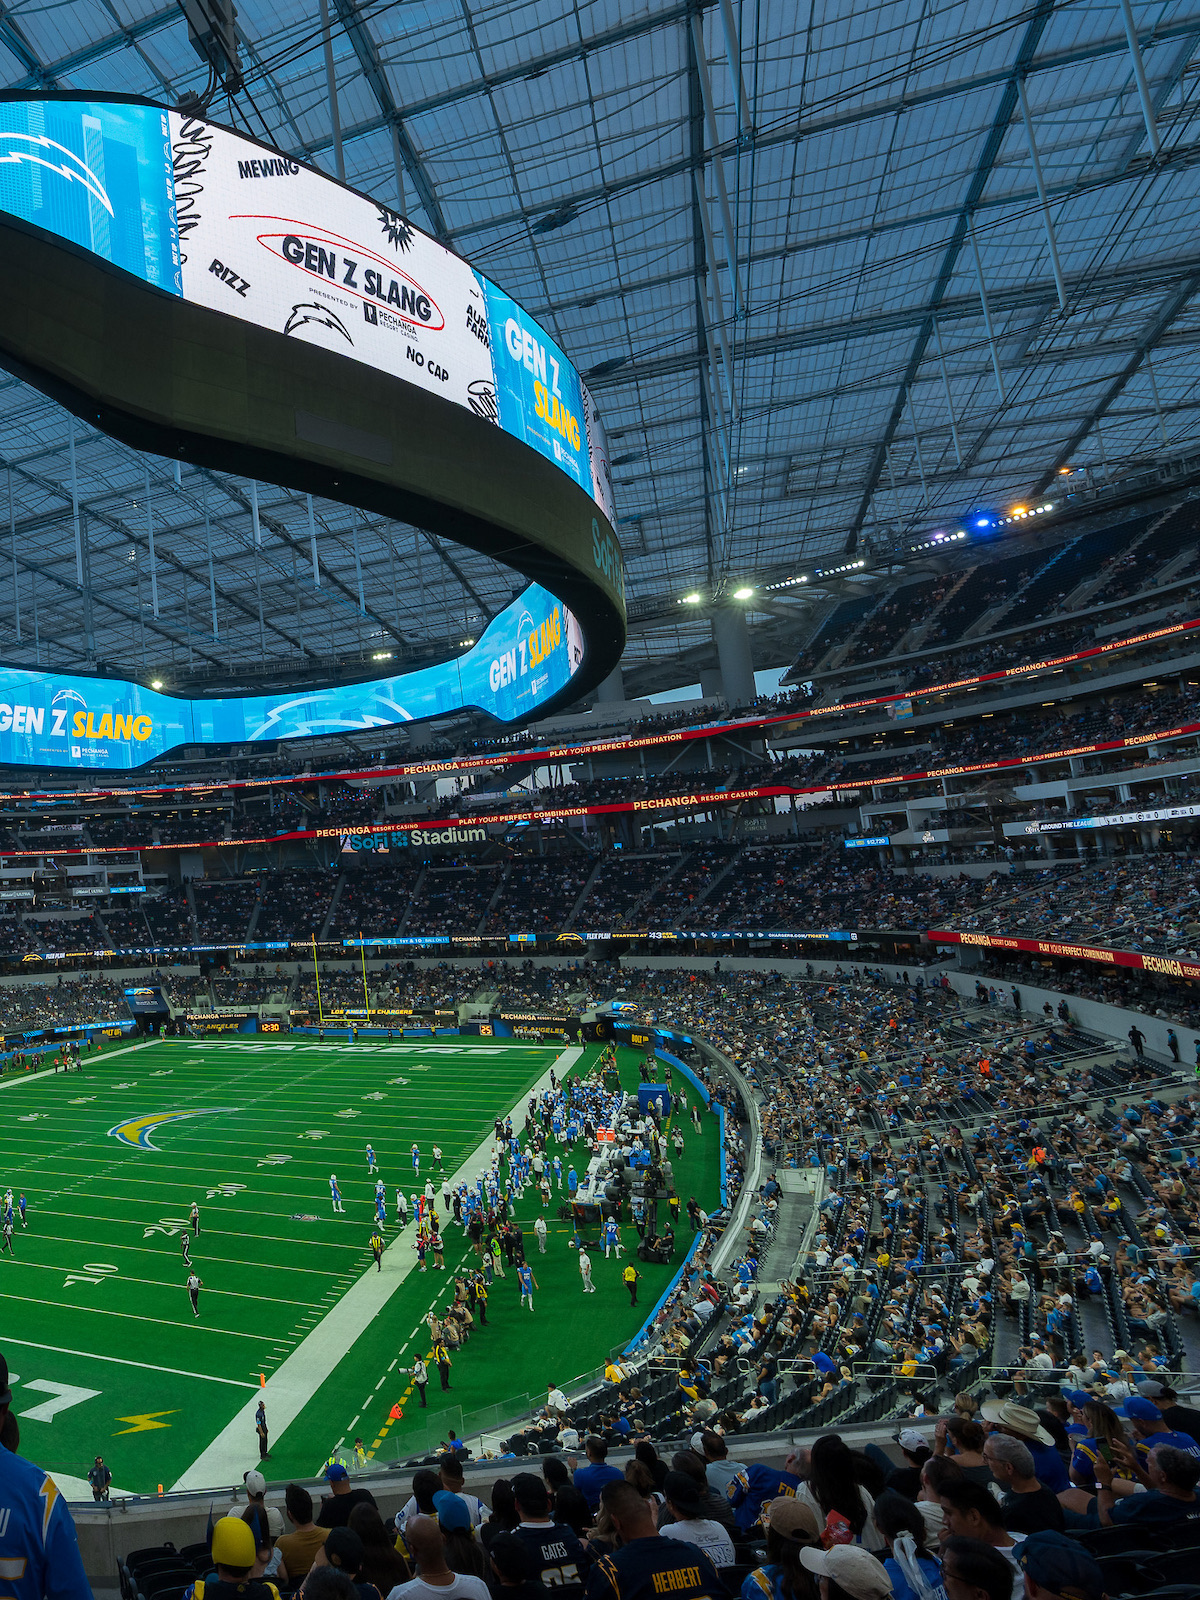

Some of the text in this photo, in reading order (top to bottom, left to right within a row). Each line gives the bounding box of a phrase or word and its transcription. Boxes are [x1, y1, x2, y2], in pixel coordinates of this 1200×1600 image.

[238, 158, 300, 180] MEWING
[208, 257, 251, 298] RIZZ
[282, 235, 433, 322] GEN Z SLANG
[308, 287, 349, 308] PRESENTED
[379, 311, 417, 335] PECHANGA
[406, 346, 449, 382] NO CAP
[505, 317, 563, 398] GEN Z
[534, 380, 581, 452] SLANG
[529, 607, 560, 669] SLANG
[489, 639, 528, 693] GEN Z
[1006, 662, 1046, 677] PECHANGA
[810, 705, 844, 715] PECHANGA
[50, 709, 67, 736] Z
[72, 711, 153, 741] SLANG
[549, 748, 568, 757] PLAY
[592, 742, 626, 751] PERFECT
[628, 734, 681, 746] COMBINATION
[1124, 734, 1157, 745] PECHANGA
[404, 762, 458, 774] PECHANGA
[485, 754, 508, 764] CASINO
[926, 767, 964, 777] PECHANGA
[634, 796, 698, 809] PECHANGA
[730, 791, 758, 801] CASINO
[500, 813, 532, 821] PERFECT
[534, 808, 587, 818] COMBINATION
[316, 827, 370, 836] PECHANGA
[396, 824, 418, 832] CASINO
[1040, 822, 1062, 831] AROUND
[1073, 820, 1093, 828] LEAGUE
[351, 828, 486, 850] SoFi Stadium
[959, 933, 991, 945] PECHANGA
[1038, 943, 1114, 961] PLAY YOUR PERFECT COMBINATION
[1142, 956, 1184, 975] PECHANGA
[186, 1013, 220, 1021] PECHANGA
[501, 1013, 537, 1021] PECHANGA
[261, 1023, 281, 1032] 12:30
[480, 1025, 492, 1036] 25
[205, 1182, 248, 1199] 30
[143, 1217, 191, 1238] 20
[606, 1225, 617, 1233] 47
[63, 1263, 119, 1288] 10
[540, 1540, 568, 1560] GATES
[651, 1565, 701, 1595] HERBERT
